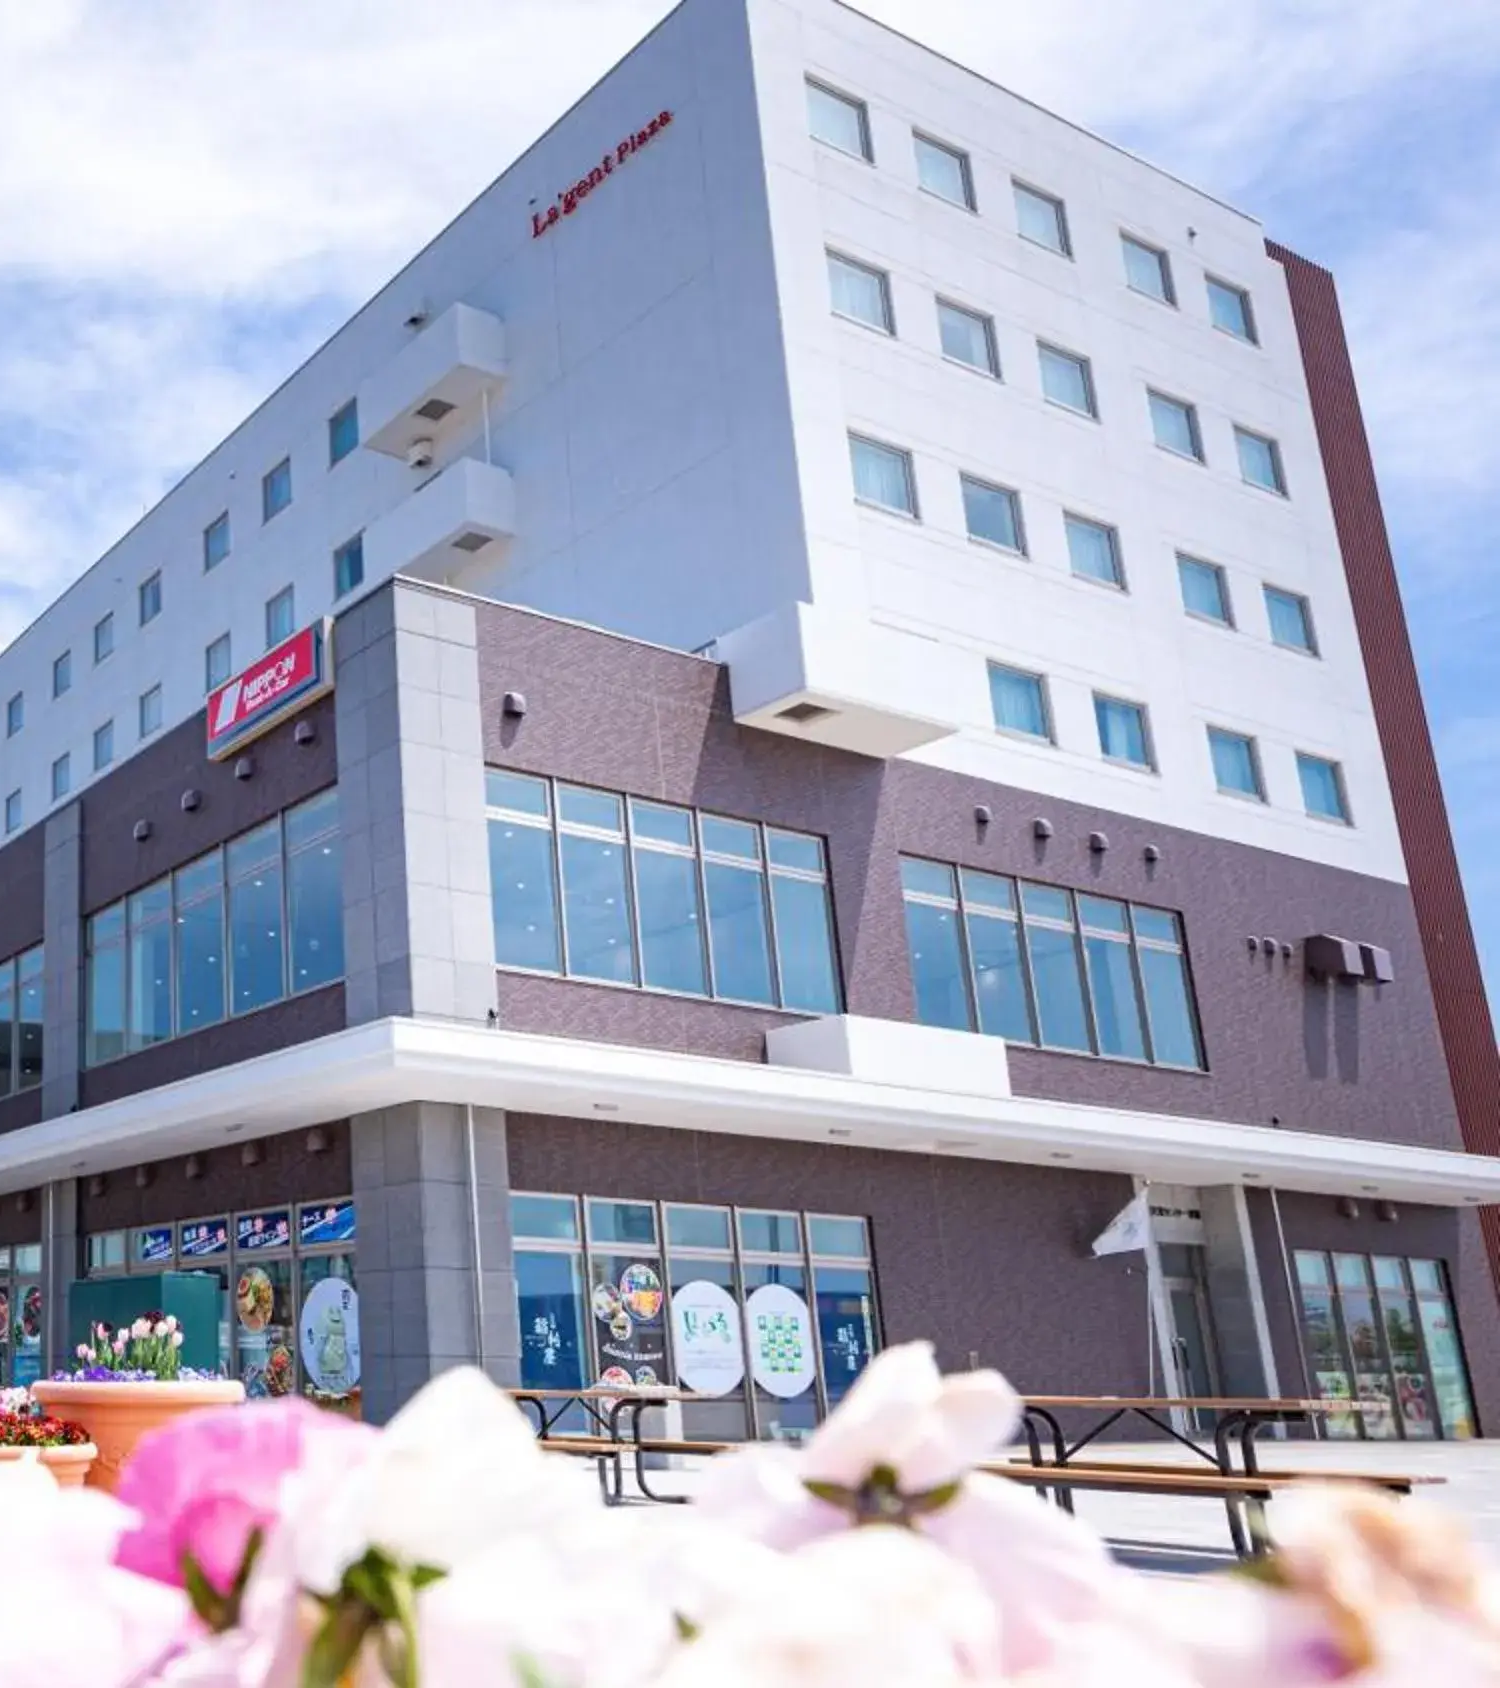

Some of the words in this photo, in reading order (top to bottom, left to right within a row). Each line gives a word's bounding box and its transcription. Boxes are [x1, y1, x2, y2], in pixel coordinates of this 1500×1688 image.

[531, 154, 613, 239] La'gent
[615, 109, 672, 165] Plaza
[243, 652, 296, 703] NIPPON
